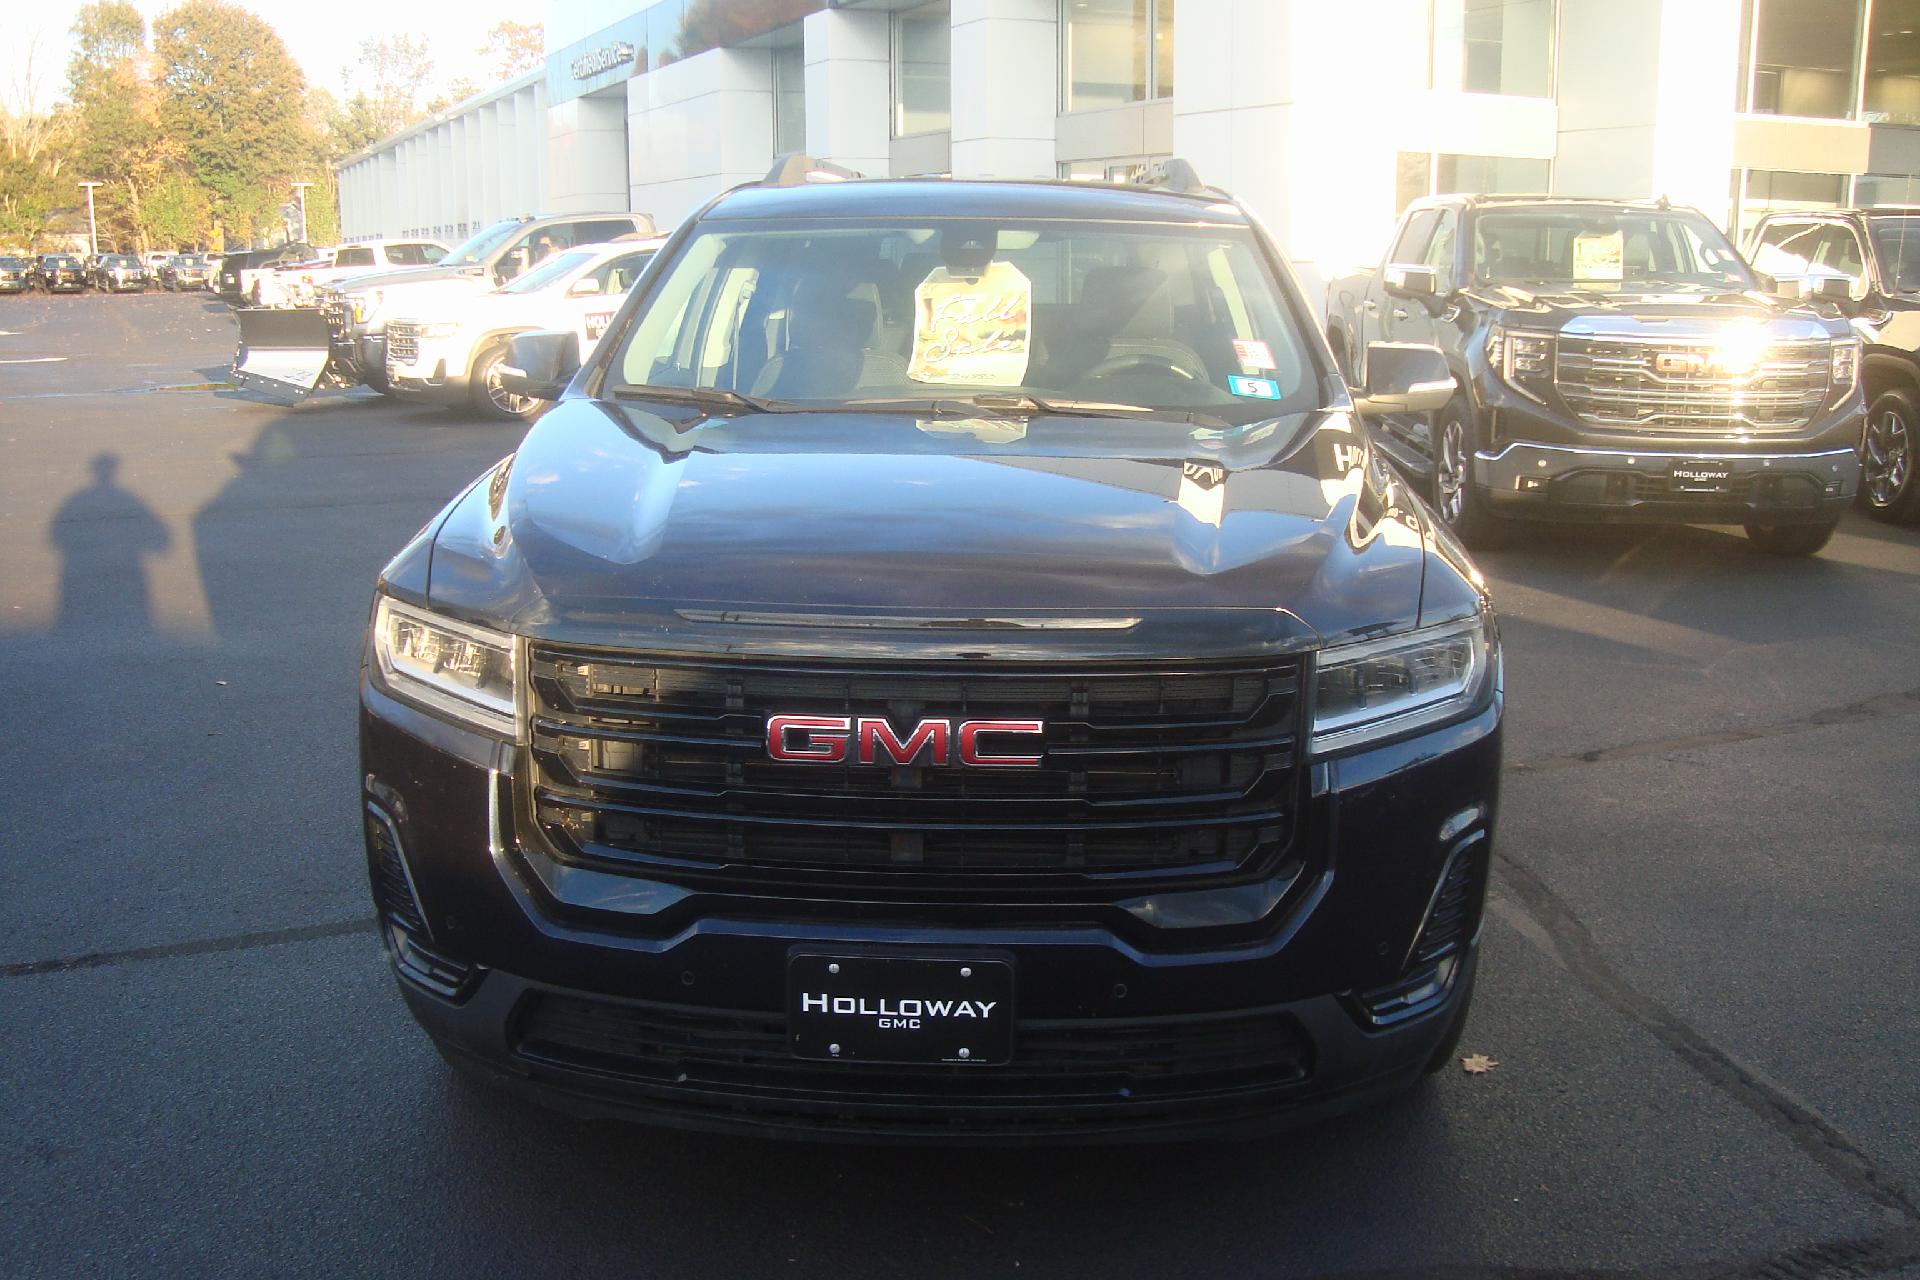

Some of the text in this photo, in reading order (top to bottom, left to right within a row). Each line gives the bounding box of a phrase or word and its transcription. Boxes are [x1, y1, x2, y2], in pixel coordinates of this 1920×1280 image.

[931, 291, 1024, 332] Fall
[923, 327, 1024, 363] Sale
[1247, 382, 1258, 393] 5
[1673, 470, 1728, 479] HOLLOWAY
[767, 714, 1044, 766] GMC
[802, 992, 997, 1018] HOLLOWAY
[878, 1018, 921, 1029] GMC
